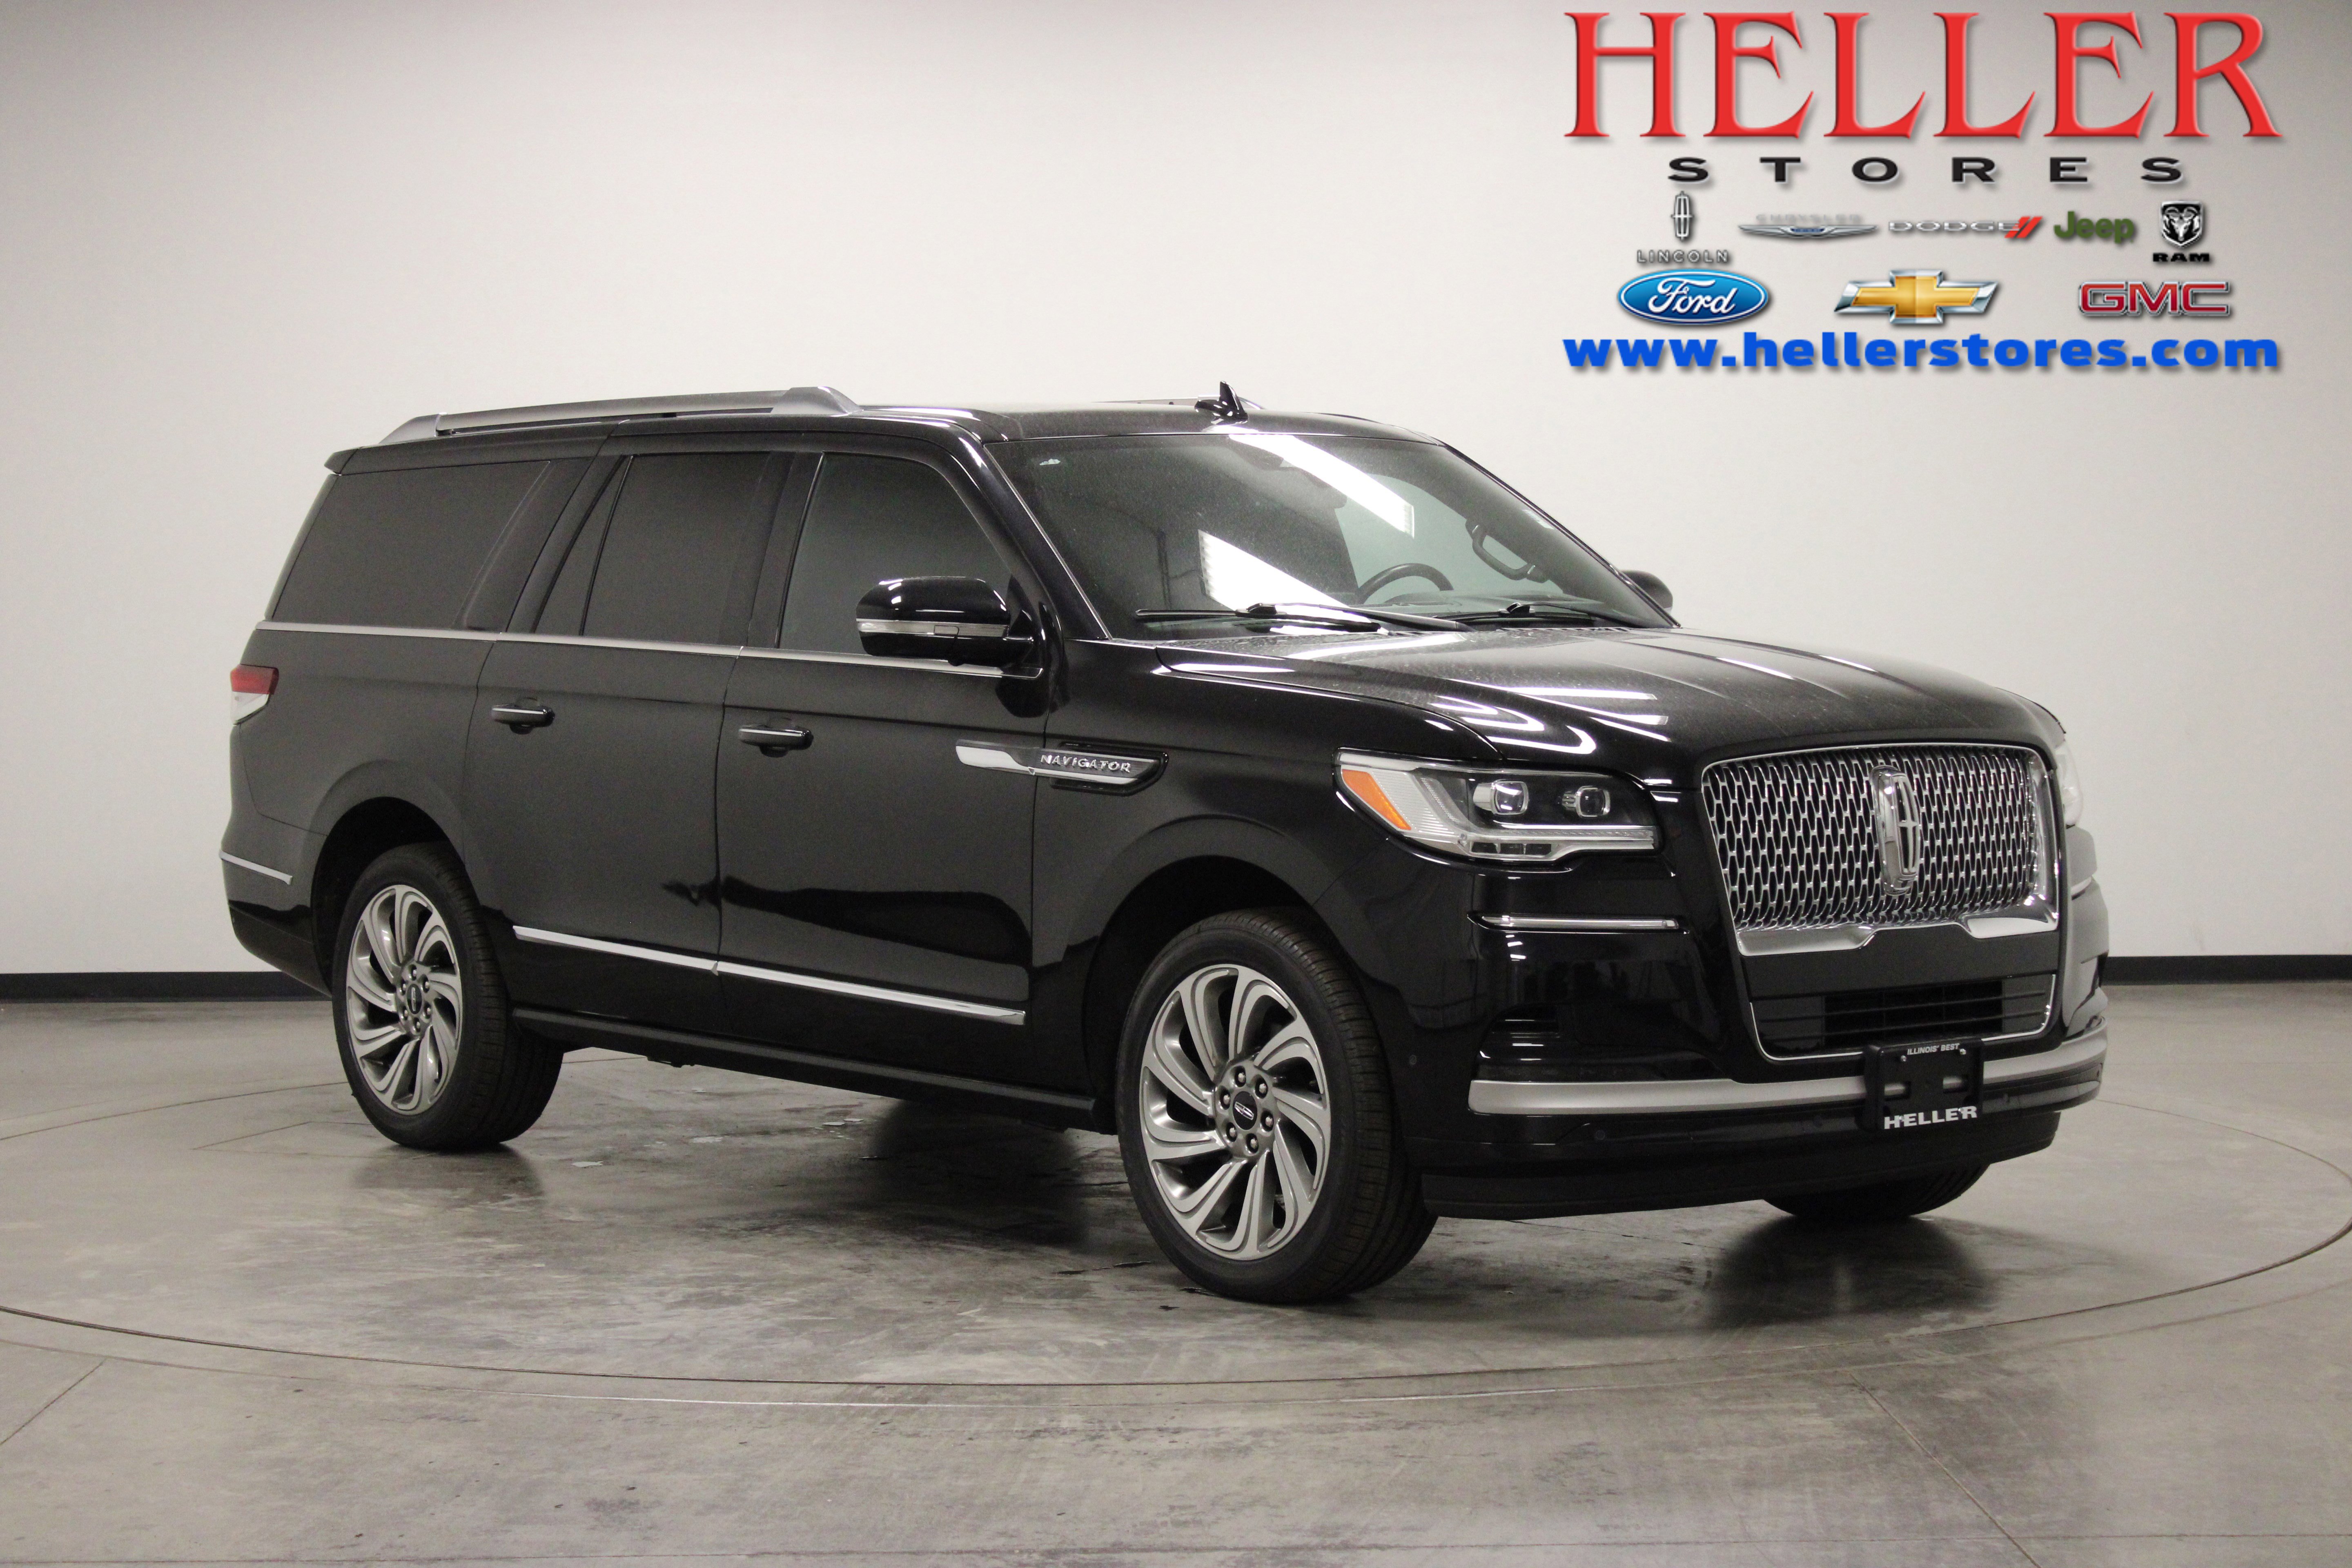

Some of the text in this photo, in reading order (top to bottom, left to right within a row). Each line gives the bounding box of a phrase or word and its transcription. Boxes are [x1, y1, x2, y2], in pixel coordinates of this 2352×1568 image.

[1040, 754, 1131, 773] NAVIGATOR
[1940, 1043, 1960, 1051] BEST
[1884, 1105, 1978, 1129] HELLER
